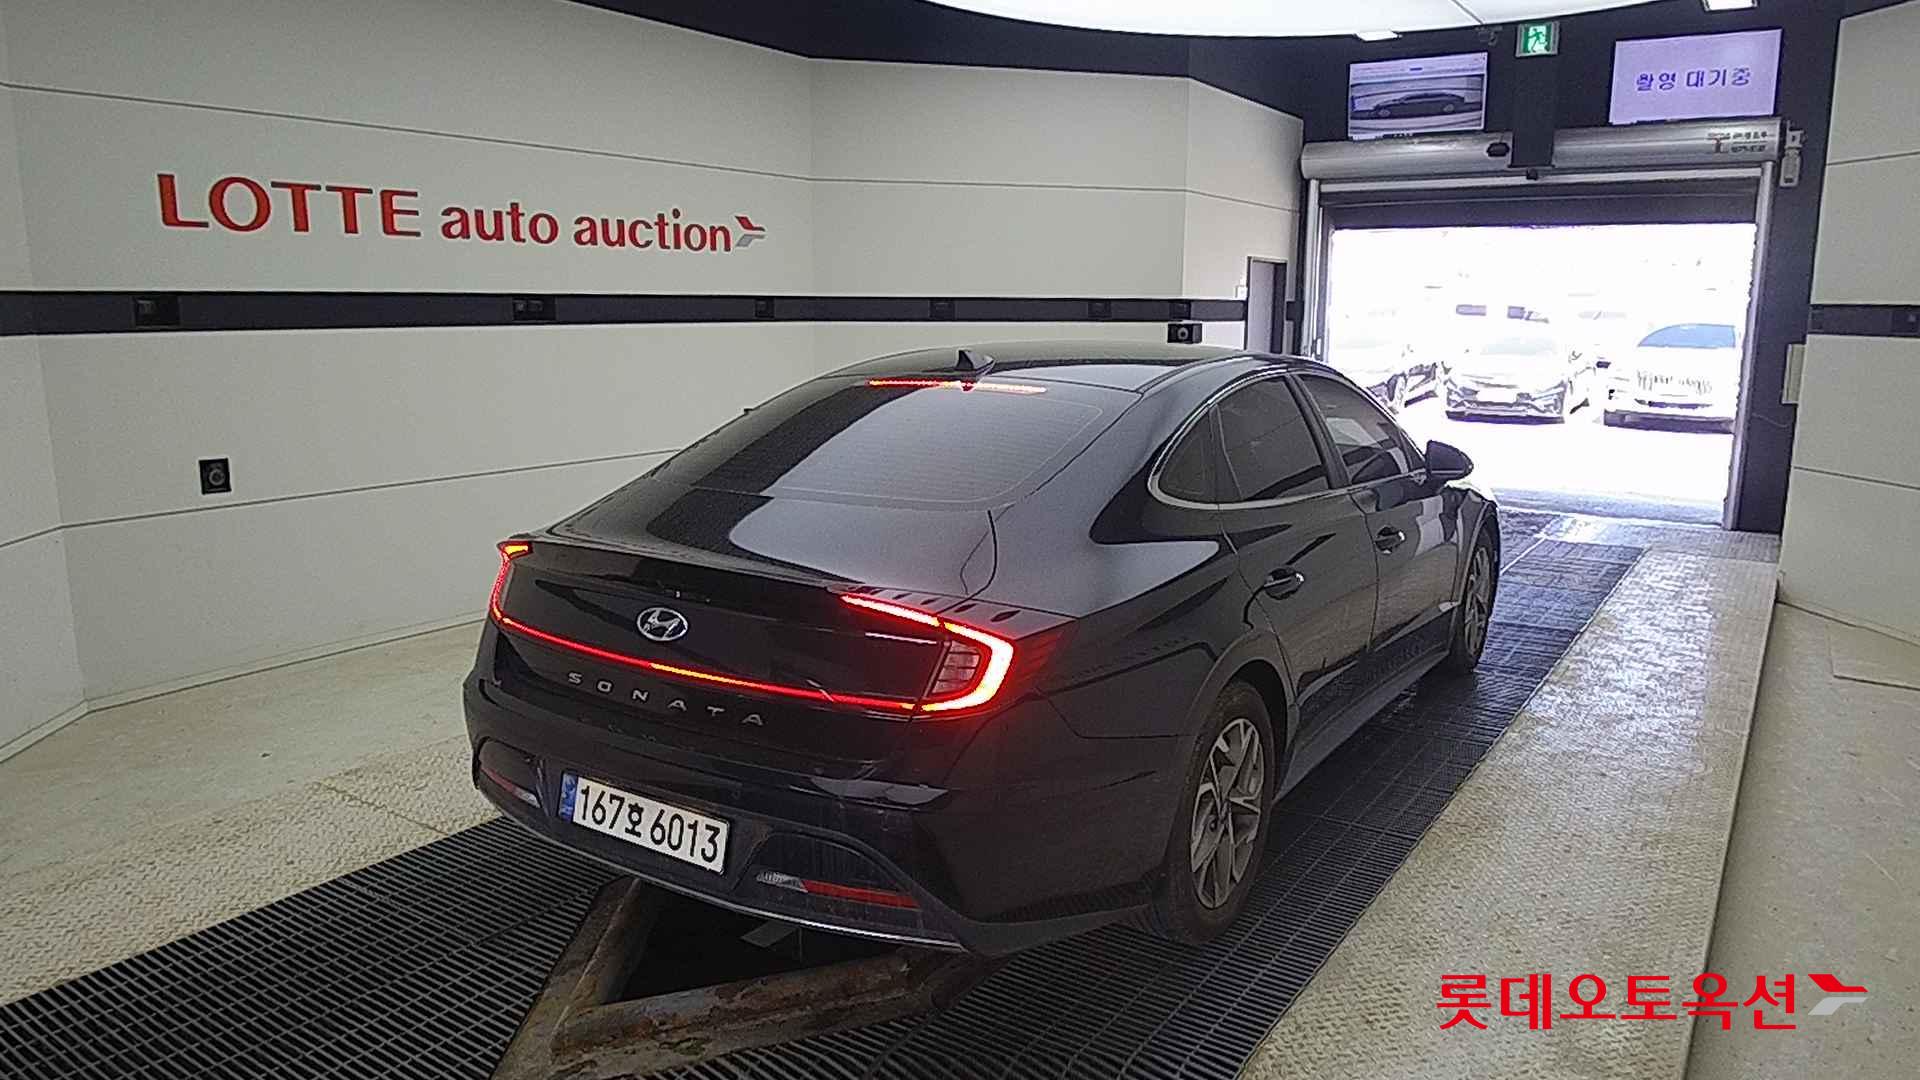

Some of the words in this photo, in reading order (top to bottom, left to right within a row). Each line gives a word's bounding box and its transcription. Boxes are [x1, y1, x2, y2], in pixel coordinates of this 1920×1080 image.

[1686, 67, 1751, 87] 대기중
[157, 173, 421, 237] LOTTE
[441, 202, 559, 244] auto
[574, 208, 731, 252] auction
[568, 671, 763, 726] SONATA
[650, 809, 721, 863] 6013
